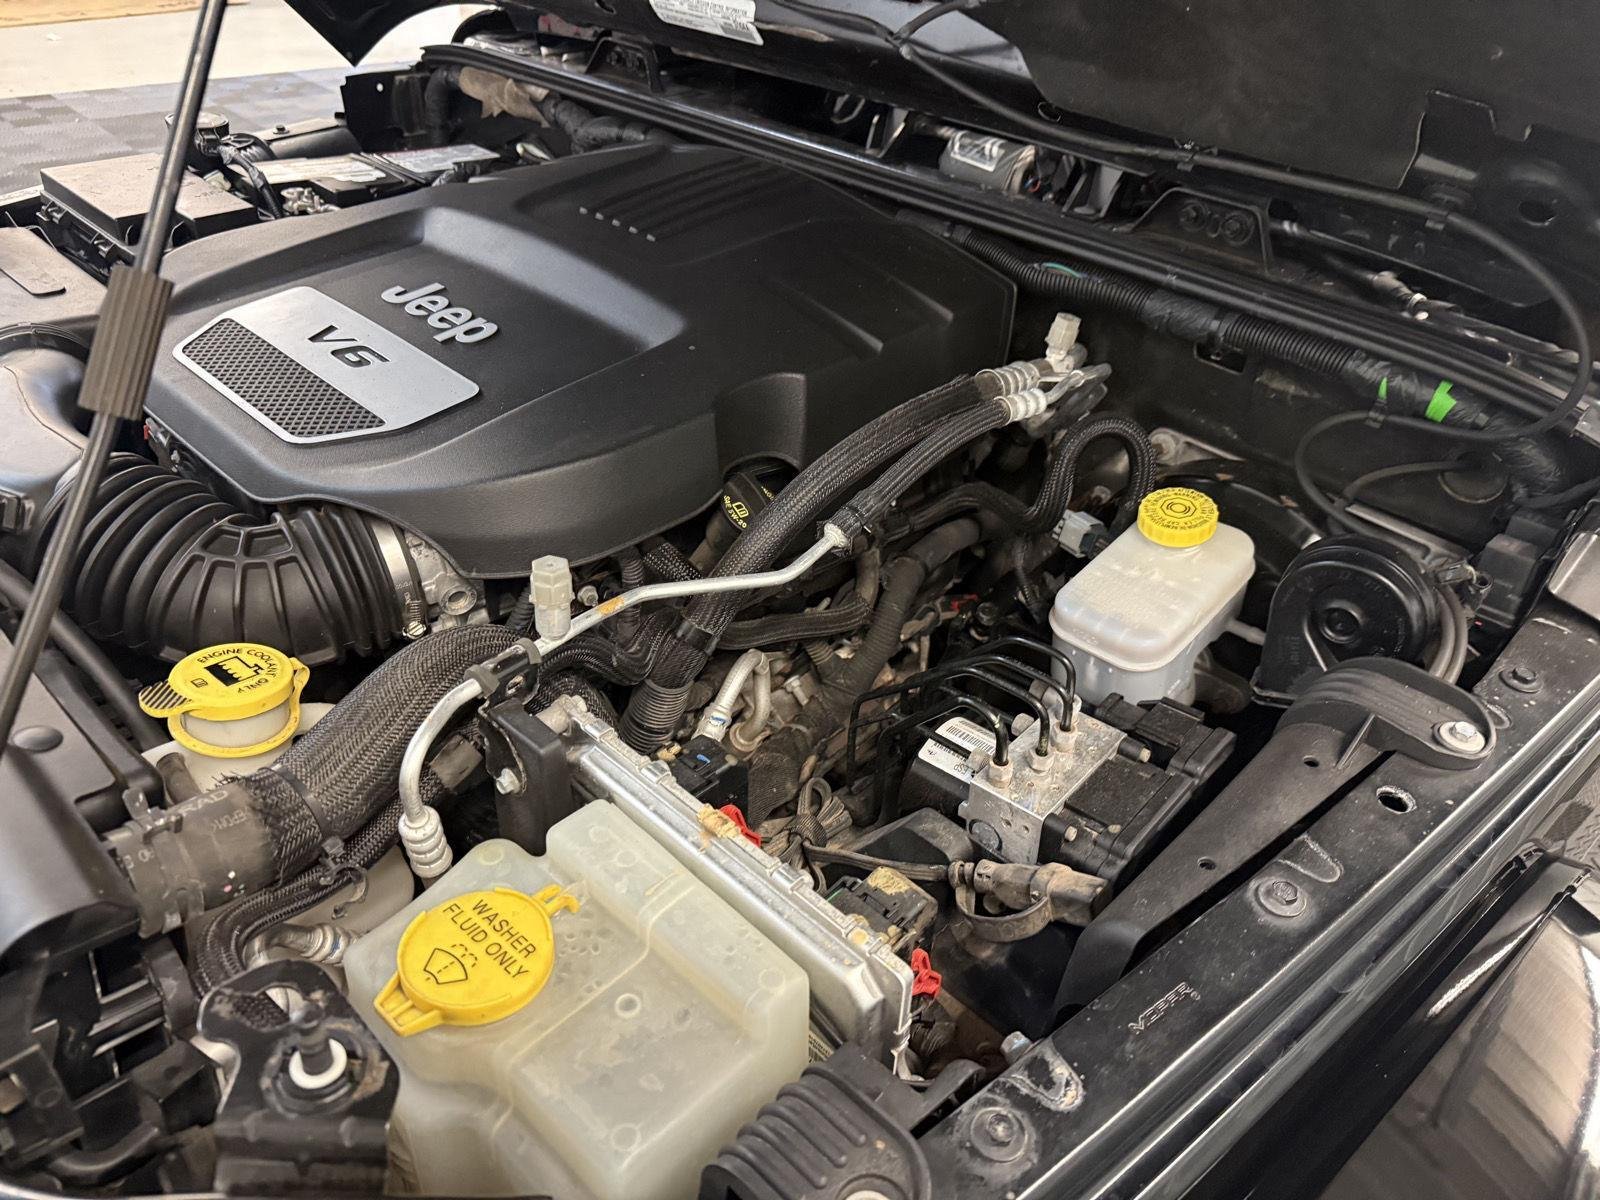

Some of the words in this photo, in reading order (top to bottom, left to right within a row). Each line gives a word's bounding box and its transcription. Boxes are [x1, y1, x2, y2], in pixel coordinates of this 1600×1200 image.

[381, 282, 498, 343] Jeep
[308, 325, 390, 368] V6
[728, 509, 746, 528] 5W-20
[197, 648, 242, 664] ENGINE
[247, 649, 277, 677] COOLANT
[237, 677, 269, 693] ONLY
[443, 902, 487, 943] FLUID
[485, 943, 529, 979] ONLY
[473, 899, 536, 958] WASHER
